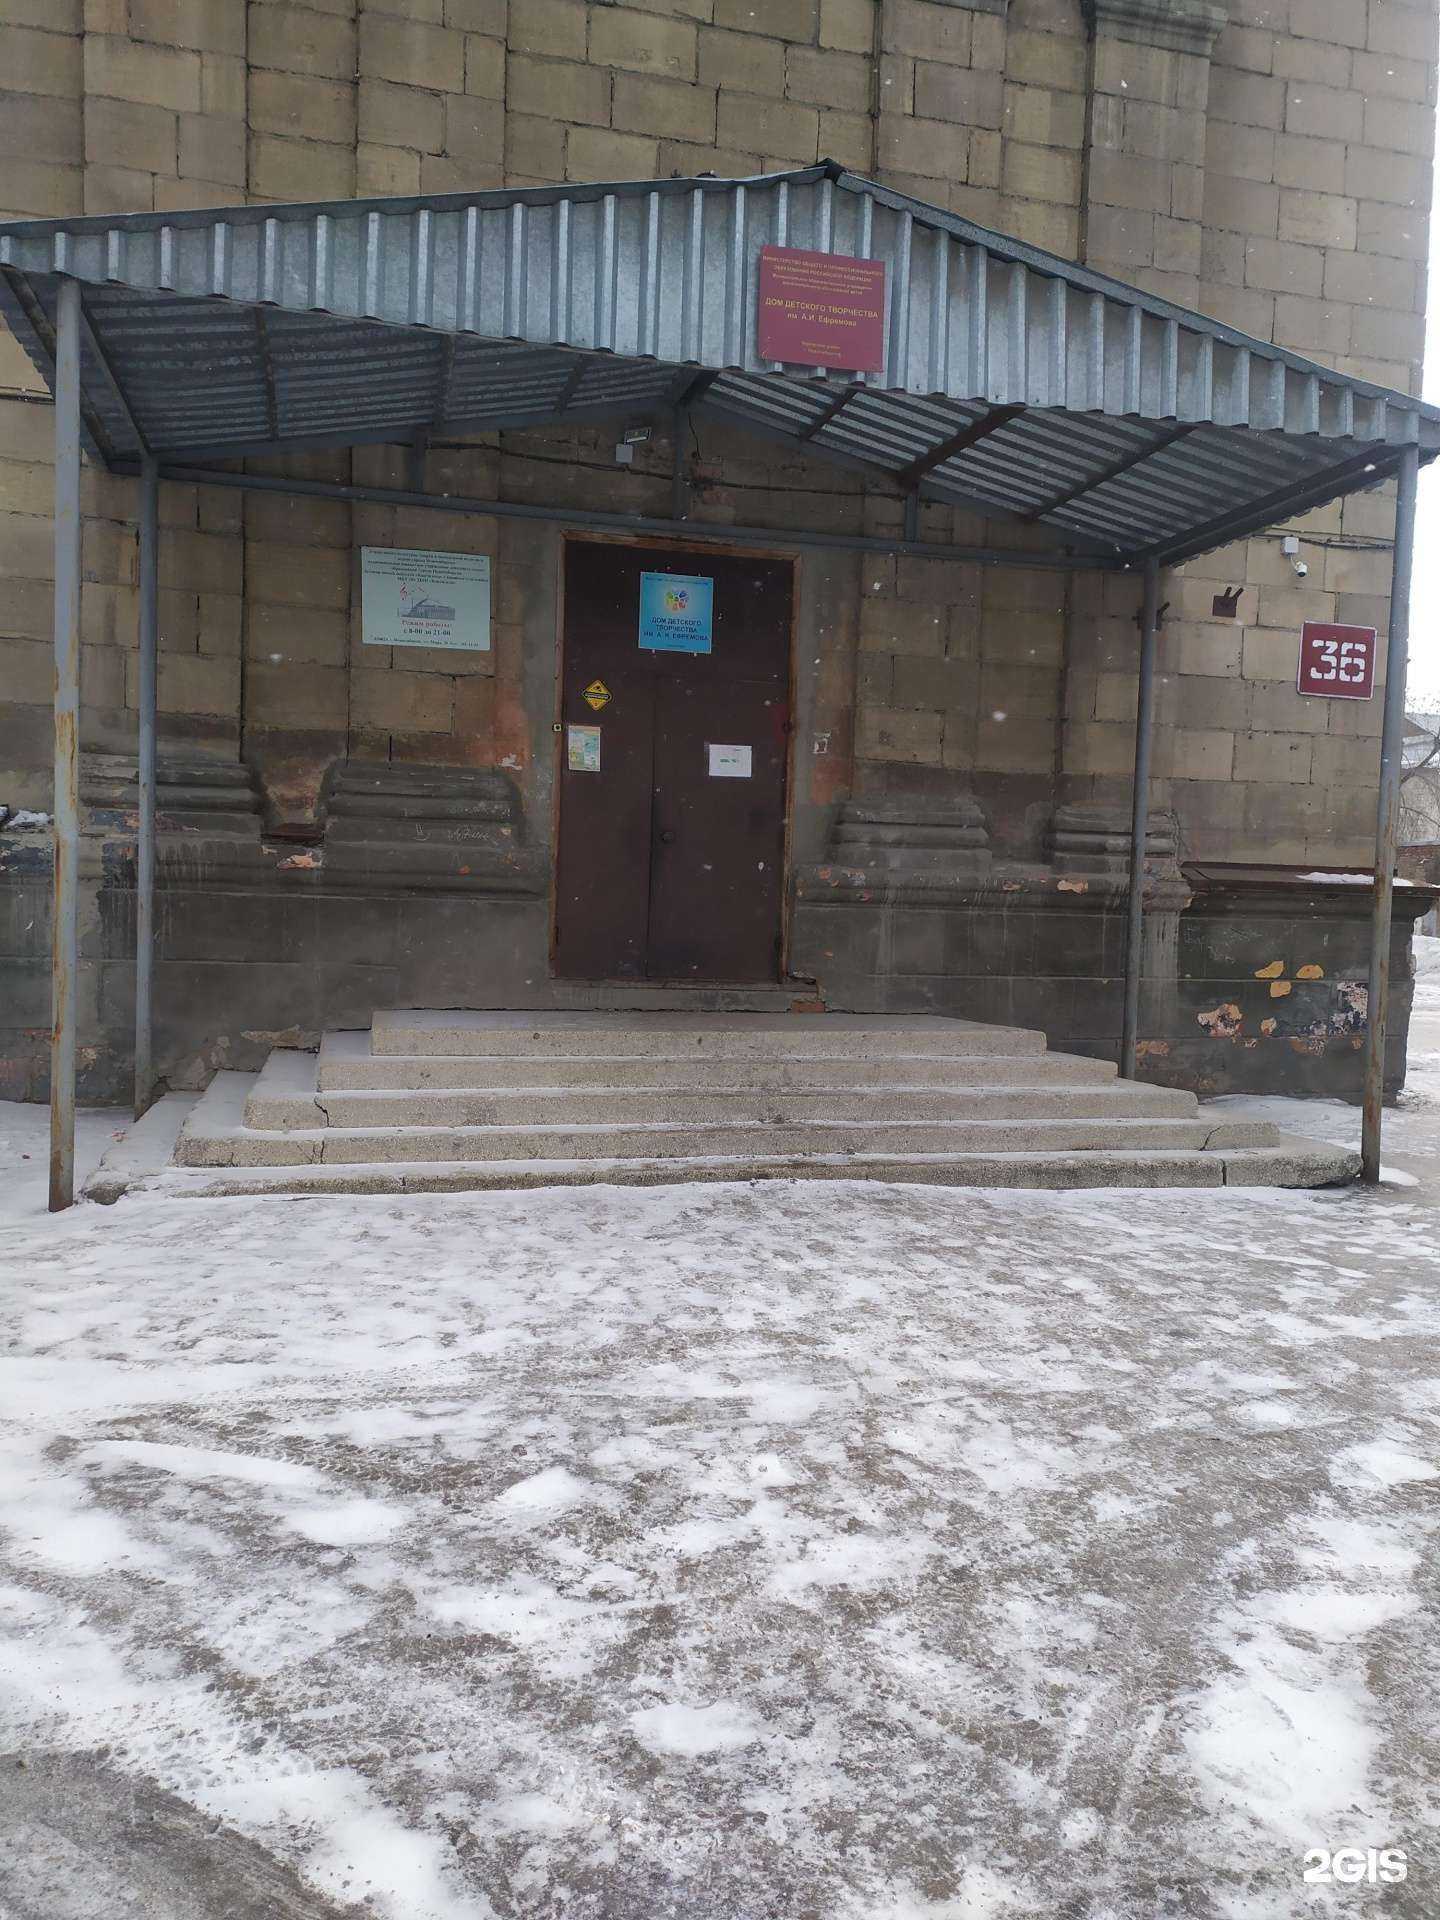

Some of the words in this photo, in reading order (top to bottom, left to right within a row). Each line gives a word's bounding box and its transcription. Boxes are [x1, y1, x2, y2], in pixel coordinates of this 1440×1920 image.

[765, 297, 784, 307] ДОМ
[785, 300, 826, 312] ДЕТСКОГО
[828, 305, 879, 319] ТВОРЧЕСТВА
[818, 315, 857, 327] Ефремова
[667, 618, 702, 626] ДЕТСКОГО
[656, 624, 697, 633] ТВОРЧЕСТВА
[1310, 639, 1367, 683] 36
